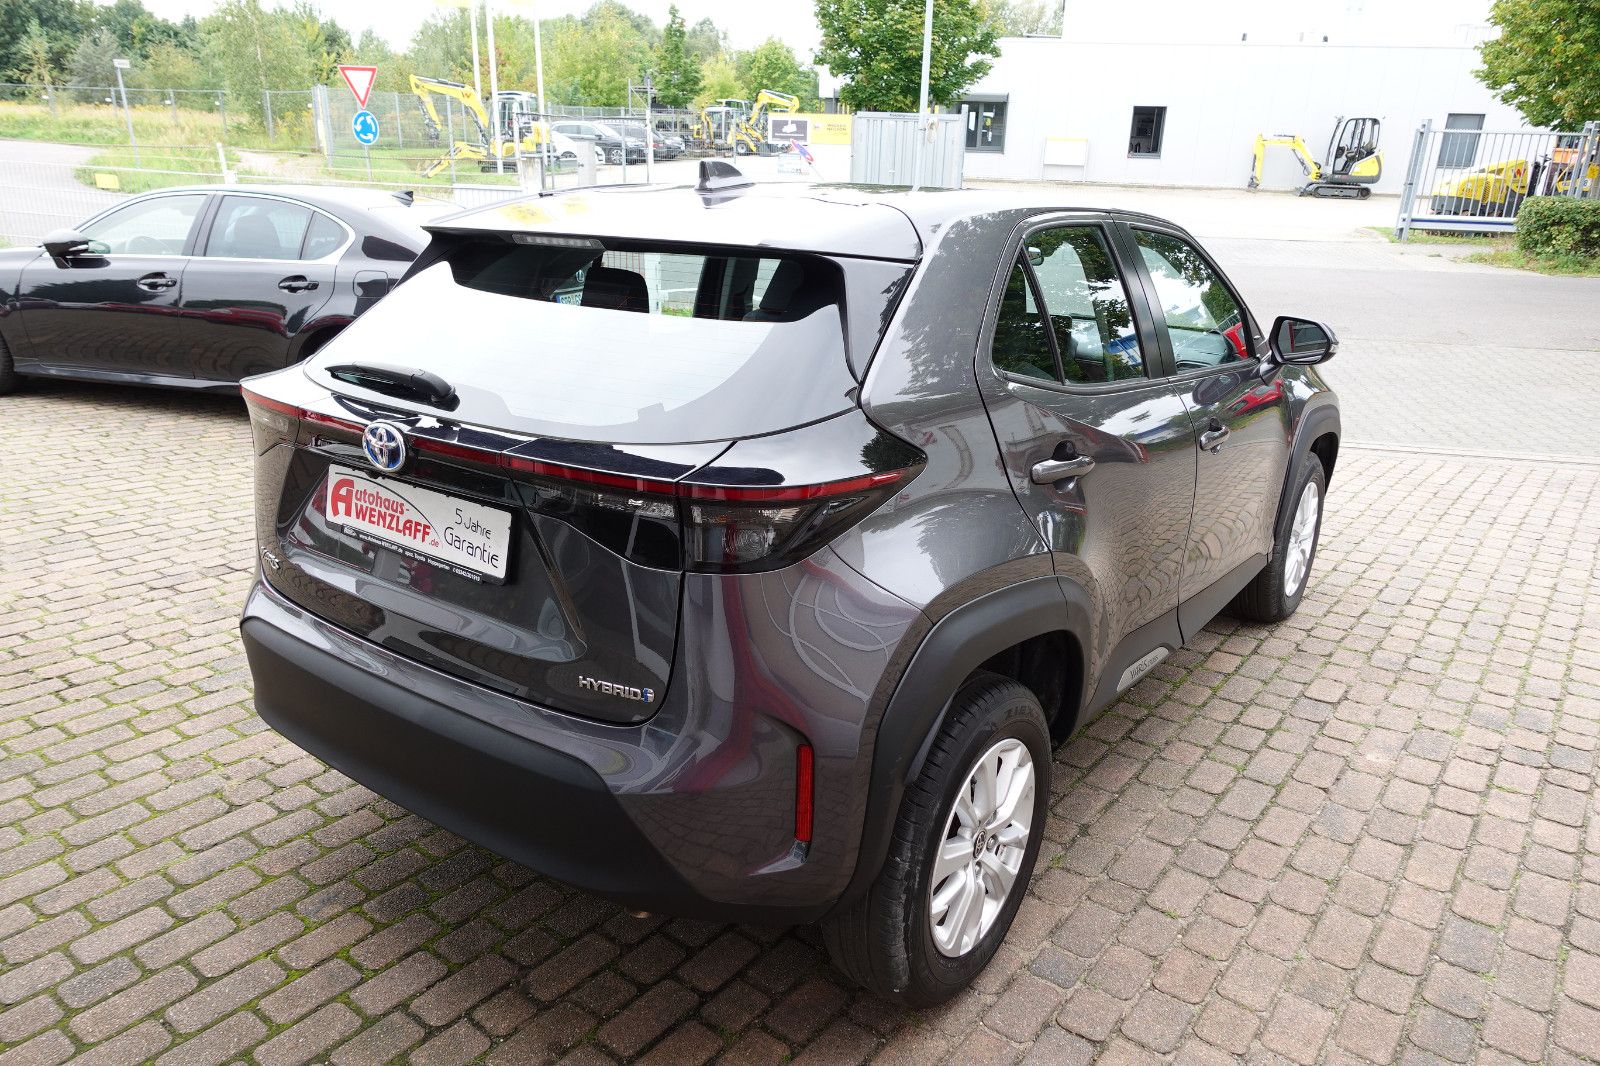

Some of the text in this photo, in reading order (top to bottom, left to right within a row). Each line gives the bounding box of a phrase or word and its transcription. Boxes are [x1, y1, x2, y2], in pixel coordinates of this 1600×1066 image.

[455, 508, 491, 539] 5 Jahre
[443, 526, 498, 569] Garantie
[579, 675, 641, 700] HYBRID
